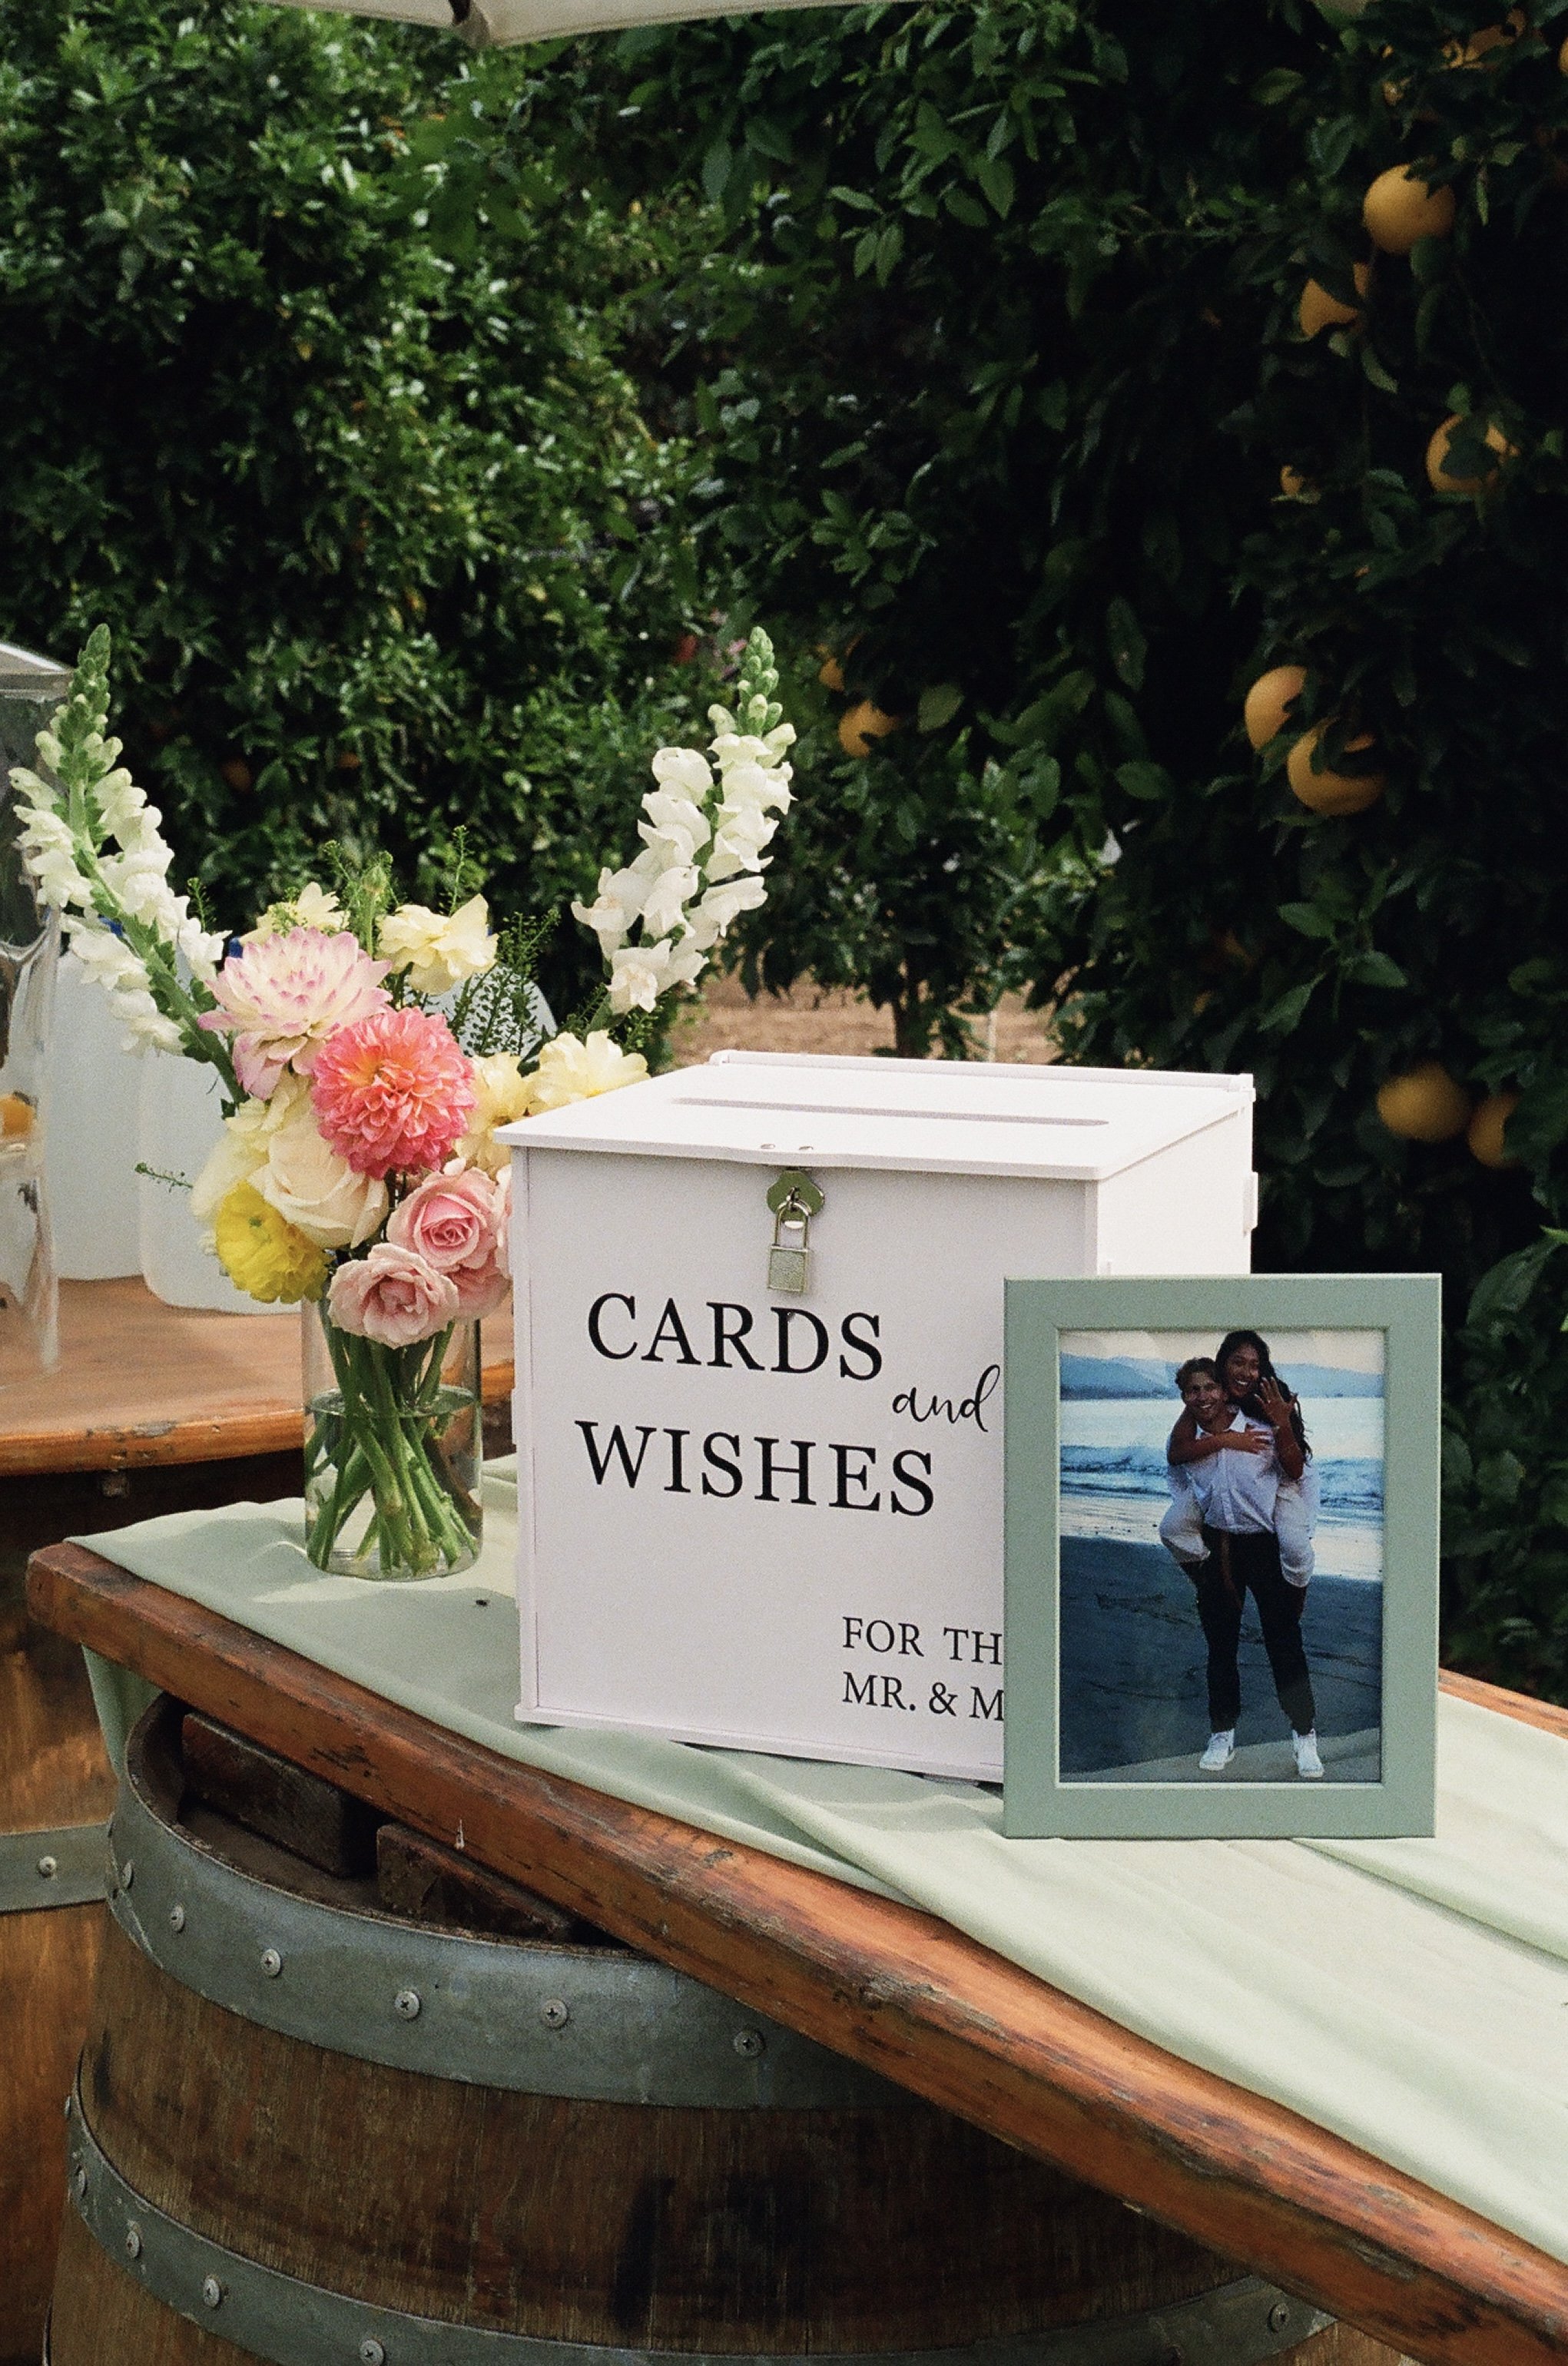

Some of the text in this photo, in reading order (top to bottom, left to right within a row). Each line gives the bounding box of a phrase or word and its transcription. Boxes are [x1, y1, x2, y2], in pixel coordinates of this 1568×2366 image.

[588, 1292, 883, 1381] CARDS
[892, 1364, 1001, 1433] and
[574, 1420, 935, 1516] WISHES
[842, 1615, 924, 1658] FOR
[842, 1671, 917, 1712] MR.
[928, 1682, 959, 1717] &
